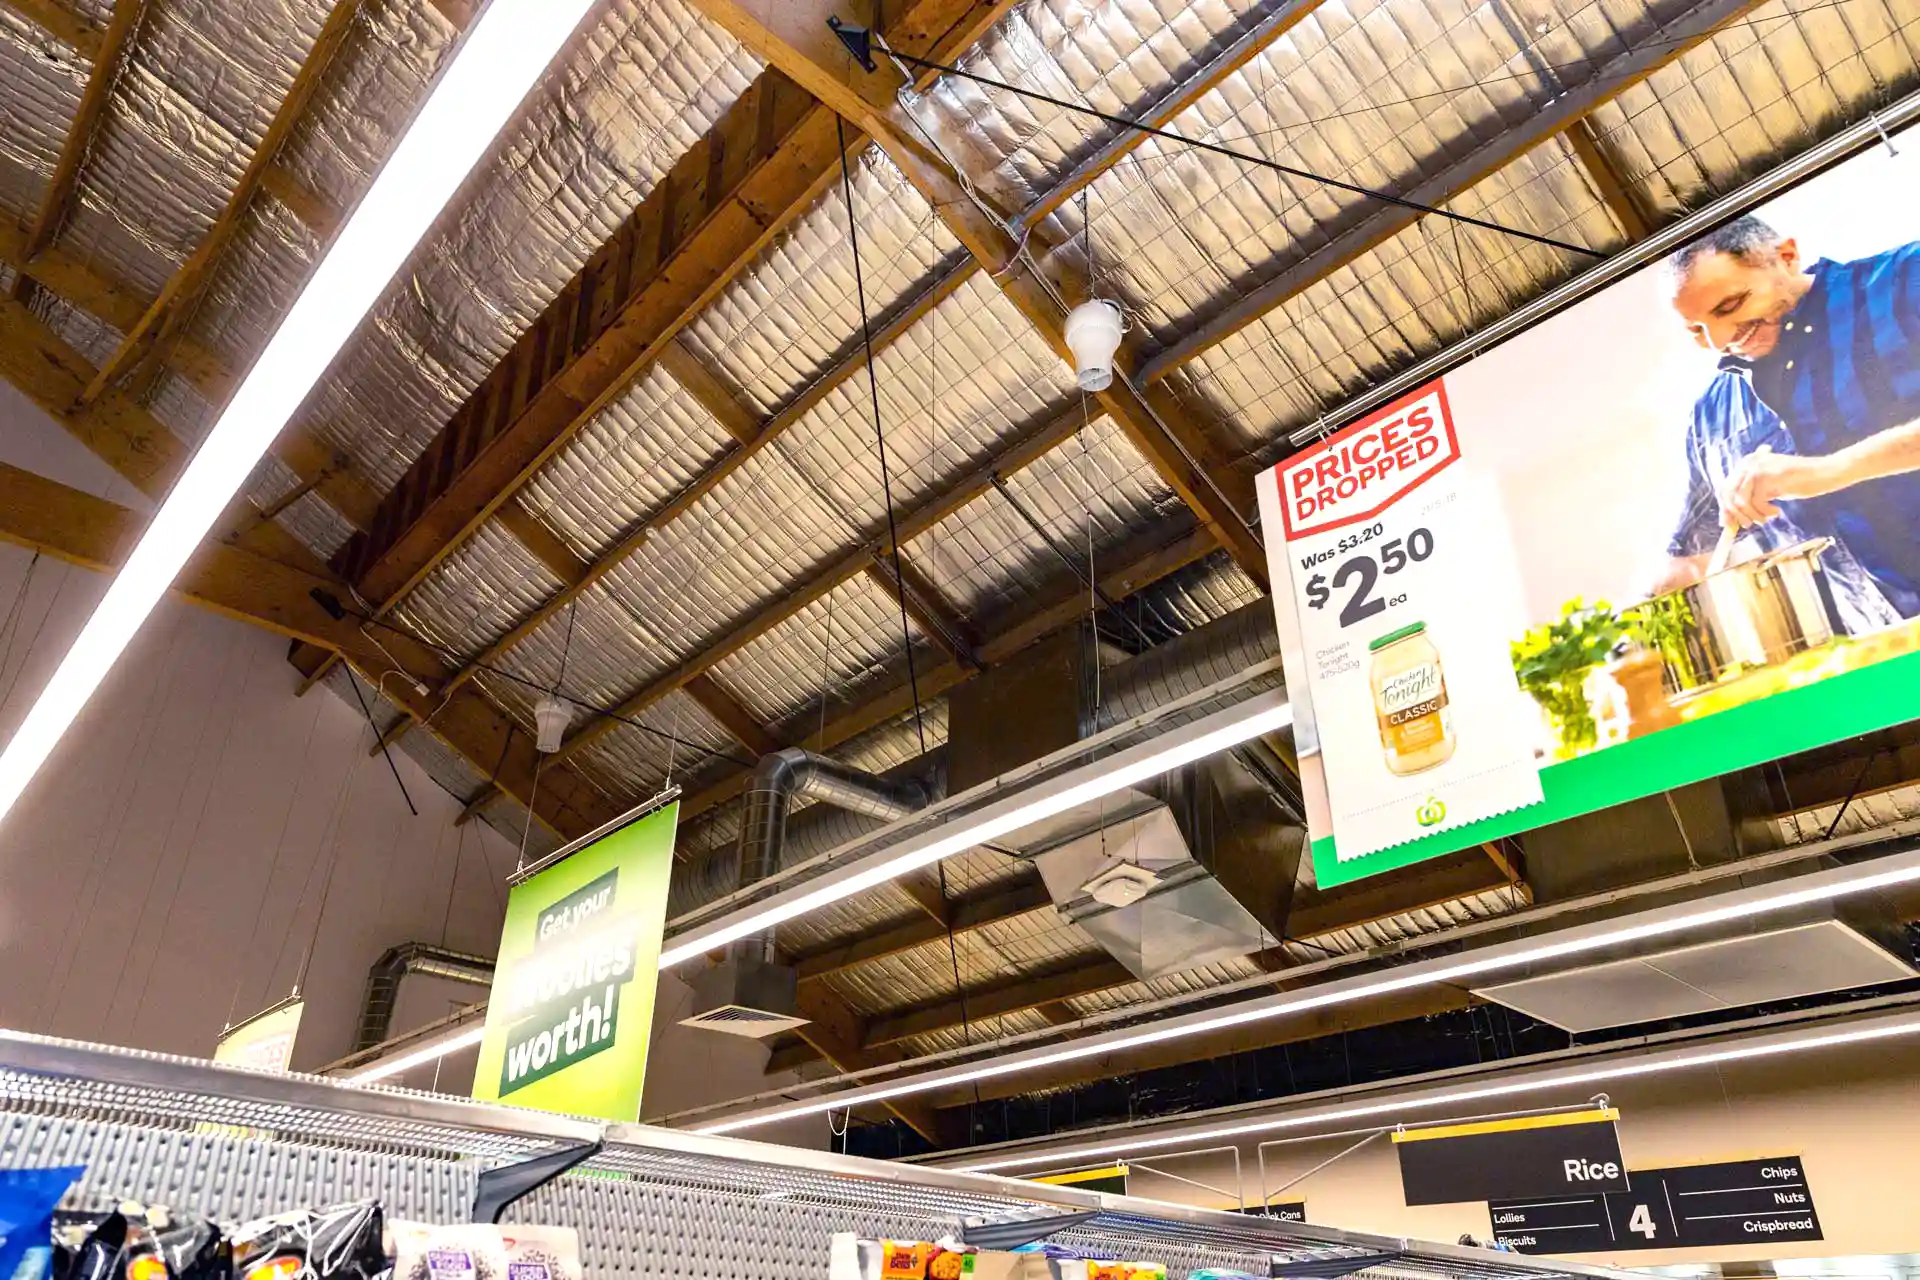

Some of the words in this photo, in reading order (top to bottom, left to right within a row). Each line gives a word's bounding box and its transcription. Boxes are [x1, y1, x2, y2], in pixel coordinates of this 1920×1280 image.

[1291, 405, 1435, 499] PRICES
[1296, 435, 1440, 521] DROPPED
[1300, 548, 1335, 570] Was
[1338, 521, 1384, 554] $3.20
[1389, 591, 1408, 608] ea
[1380, 665, 1437, 708] Tonight
[1390, 700, 1437, 725] CLASSIC
[540, 911, 569, 942] Get
[572, 886, 611, 929] your
[508, 984, 614, 1082] worth!
[1564, 1159, 1619, 1182] Rice
[1761, 1166, 1798, 1181] Chips
[1774, 1190, 1806, 1205] Nuts
[1280, 1211, 1301, 1220] Cans
[1494, 1212, 1526, 1224] Lollies
[1629, 1204, 1656, 1239] 4
[1743, 1216, 1813, 1234] Crispbread
[1498, 1235, 1537, 1247] Biscuits
